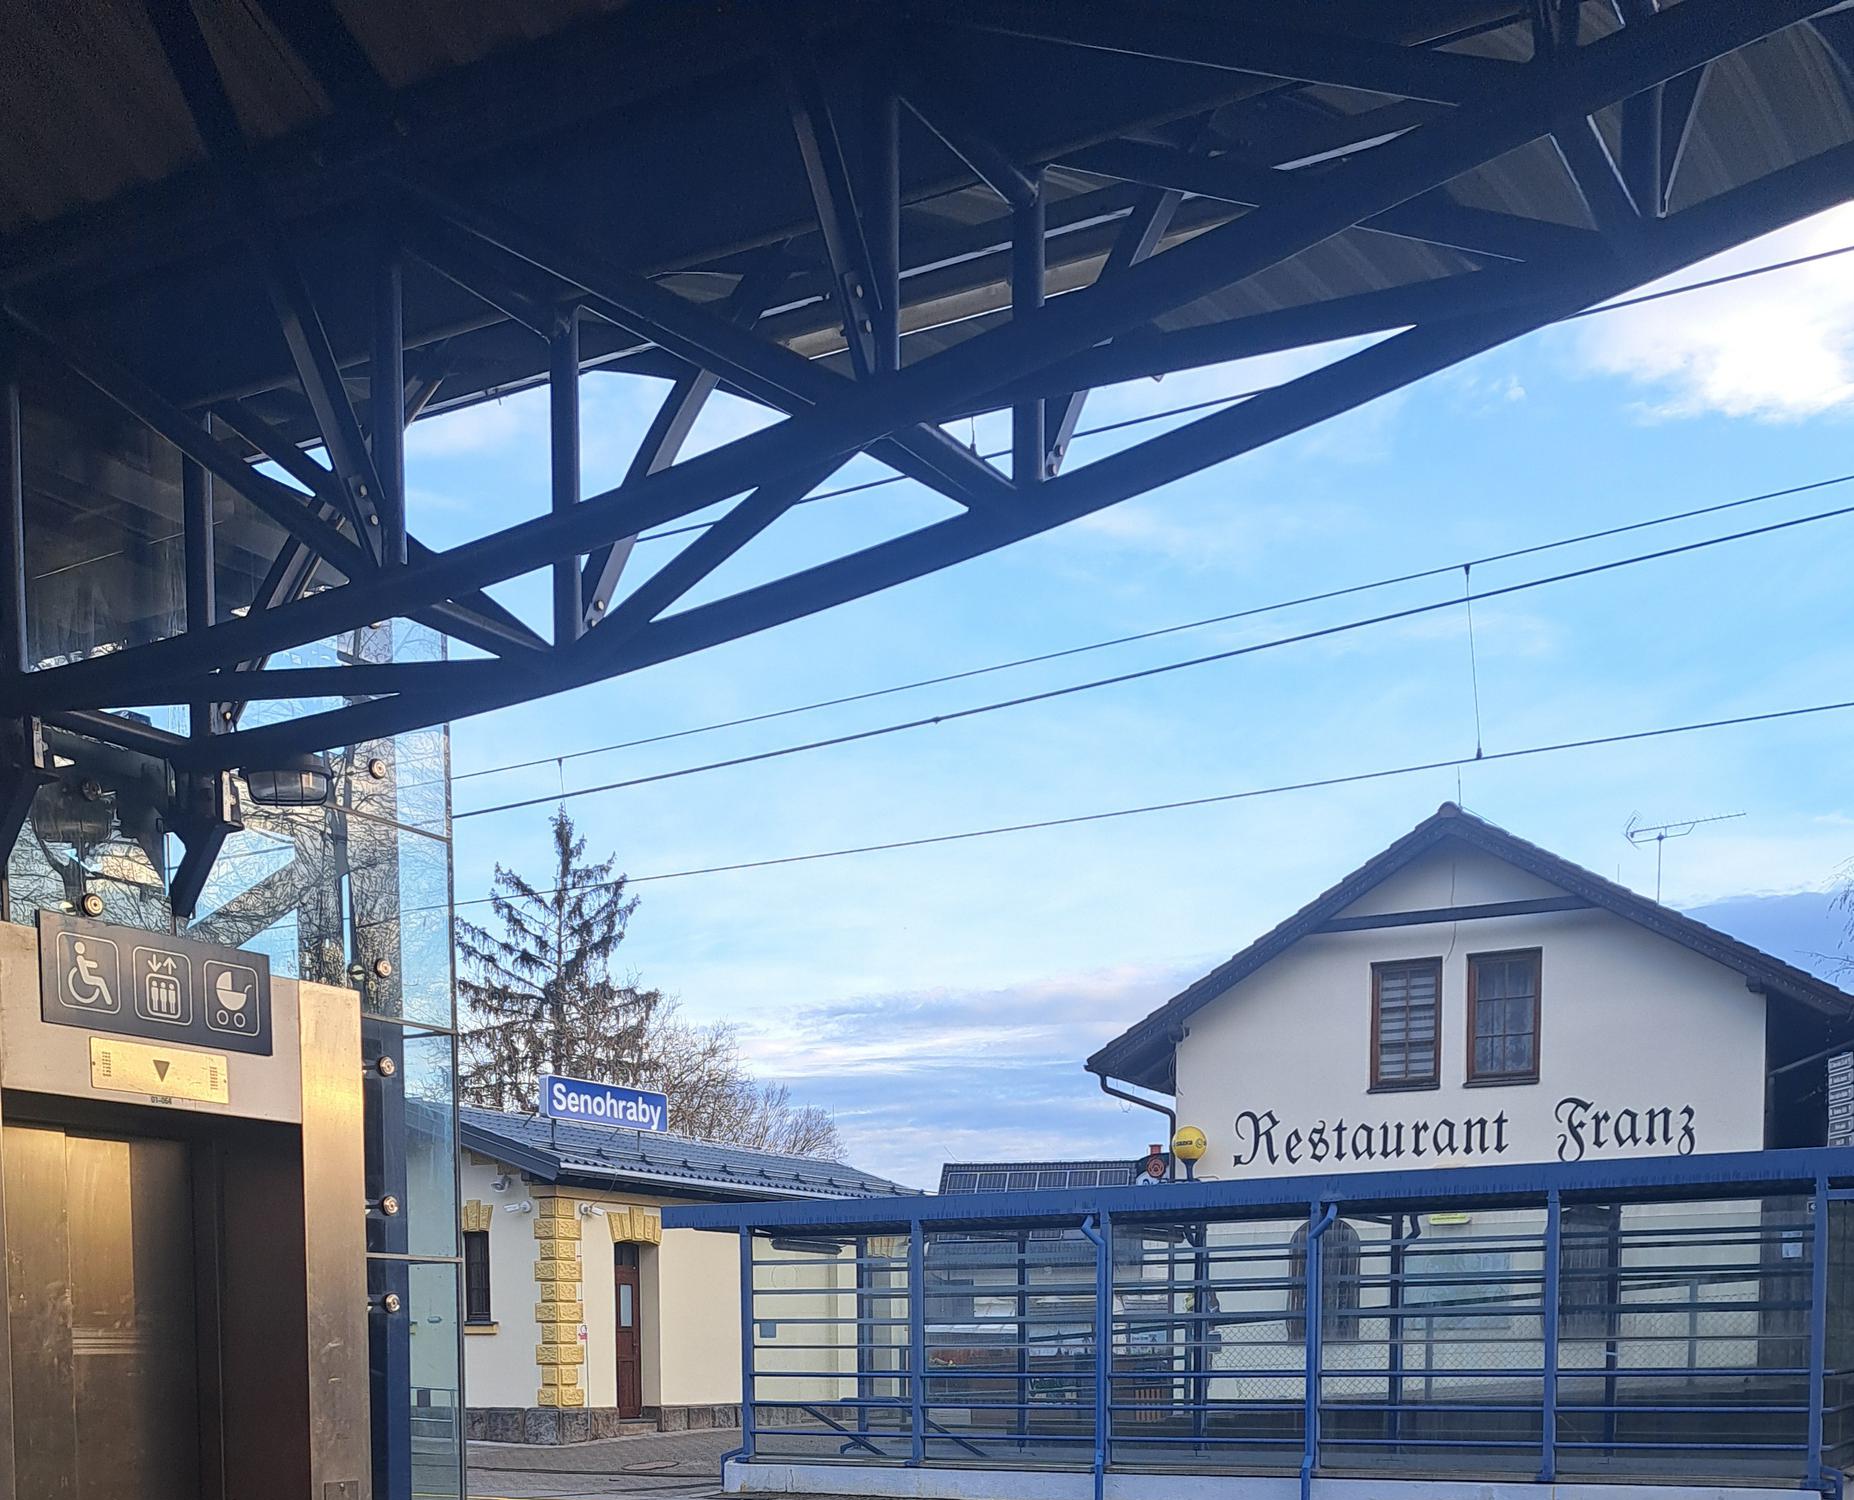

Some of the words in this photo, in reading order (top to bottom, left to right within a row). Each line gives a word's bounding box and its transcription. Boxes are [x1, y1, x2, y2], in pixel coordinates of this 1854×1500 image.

[552, 1082, 661, 1130] Senohraby
[1233, 1110, 1510, 1167] Restaurant
[1555, 1097, 1696, 1162] Franz
